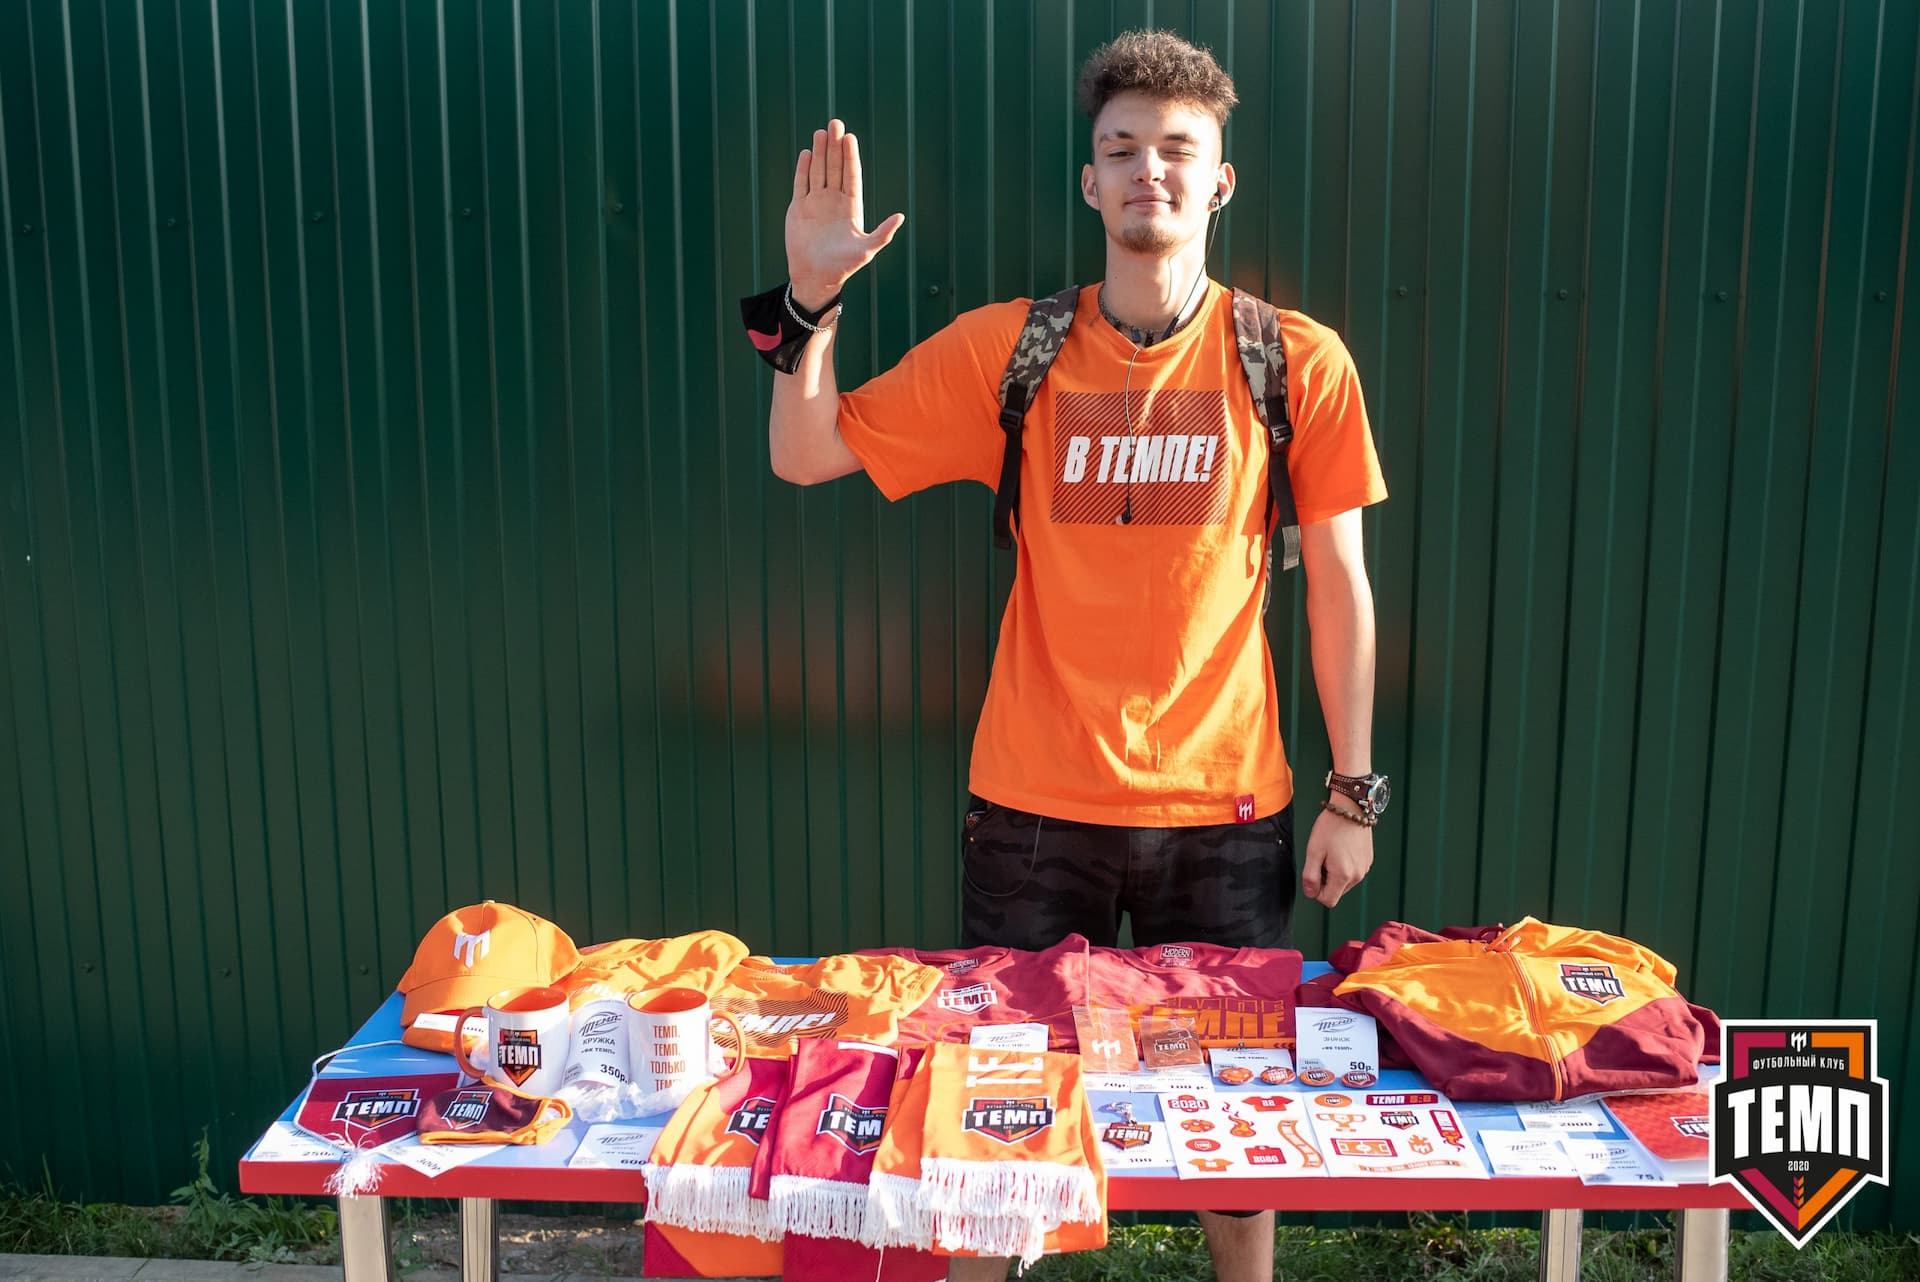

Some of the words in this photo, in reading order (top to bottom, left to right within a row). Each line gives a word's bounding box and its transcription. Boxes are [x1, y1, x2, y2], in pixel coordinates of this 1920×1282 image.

[1063, 435, 1091, 484] В
[1096, 434, 1219, 484] ТЕМПЕ!
[1565, 977, 1621, 995] ТЕМП
[942, 993, 992, 1007] ТЕМП
[653, 1025, 681, 1038] ТЕМП.
[582, 1037, 616, 1046] КРУЖКА
[500, 1045, 538, 1066] ТЕМП
[654, 1043, 681, 1056] ТЕМП.
[651, 1061, 686, 1074] ТОЛЬКО
[1349, 1061, 1375, 1072] 50р.
[1372, 1095, 1405, 1105] ТЕМП
[344, 1100, 412, 1117] ТЕМП
[450, 1102, 485, 1120] ТЕМП
[740, 1112, 769, 1129] ТЕ
[830, 1111, 882, 1137] ТЕМ
[973, 1109, 1046, 1127] ТЕМП
[1108, 1129, 1148, 1143] ТЕМП
